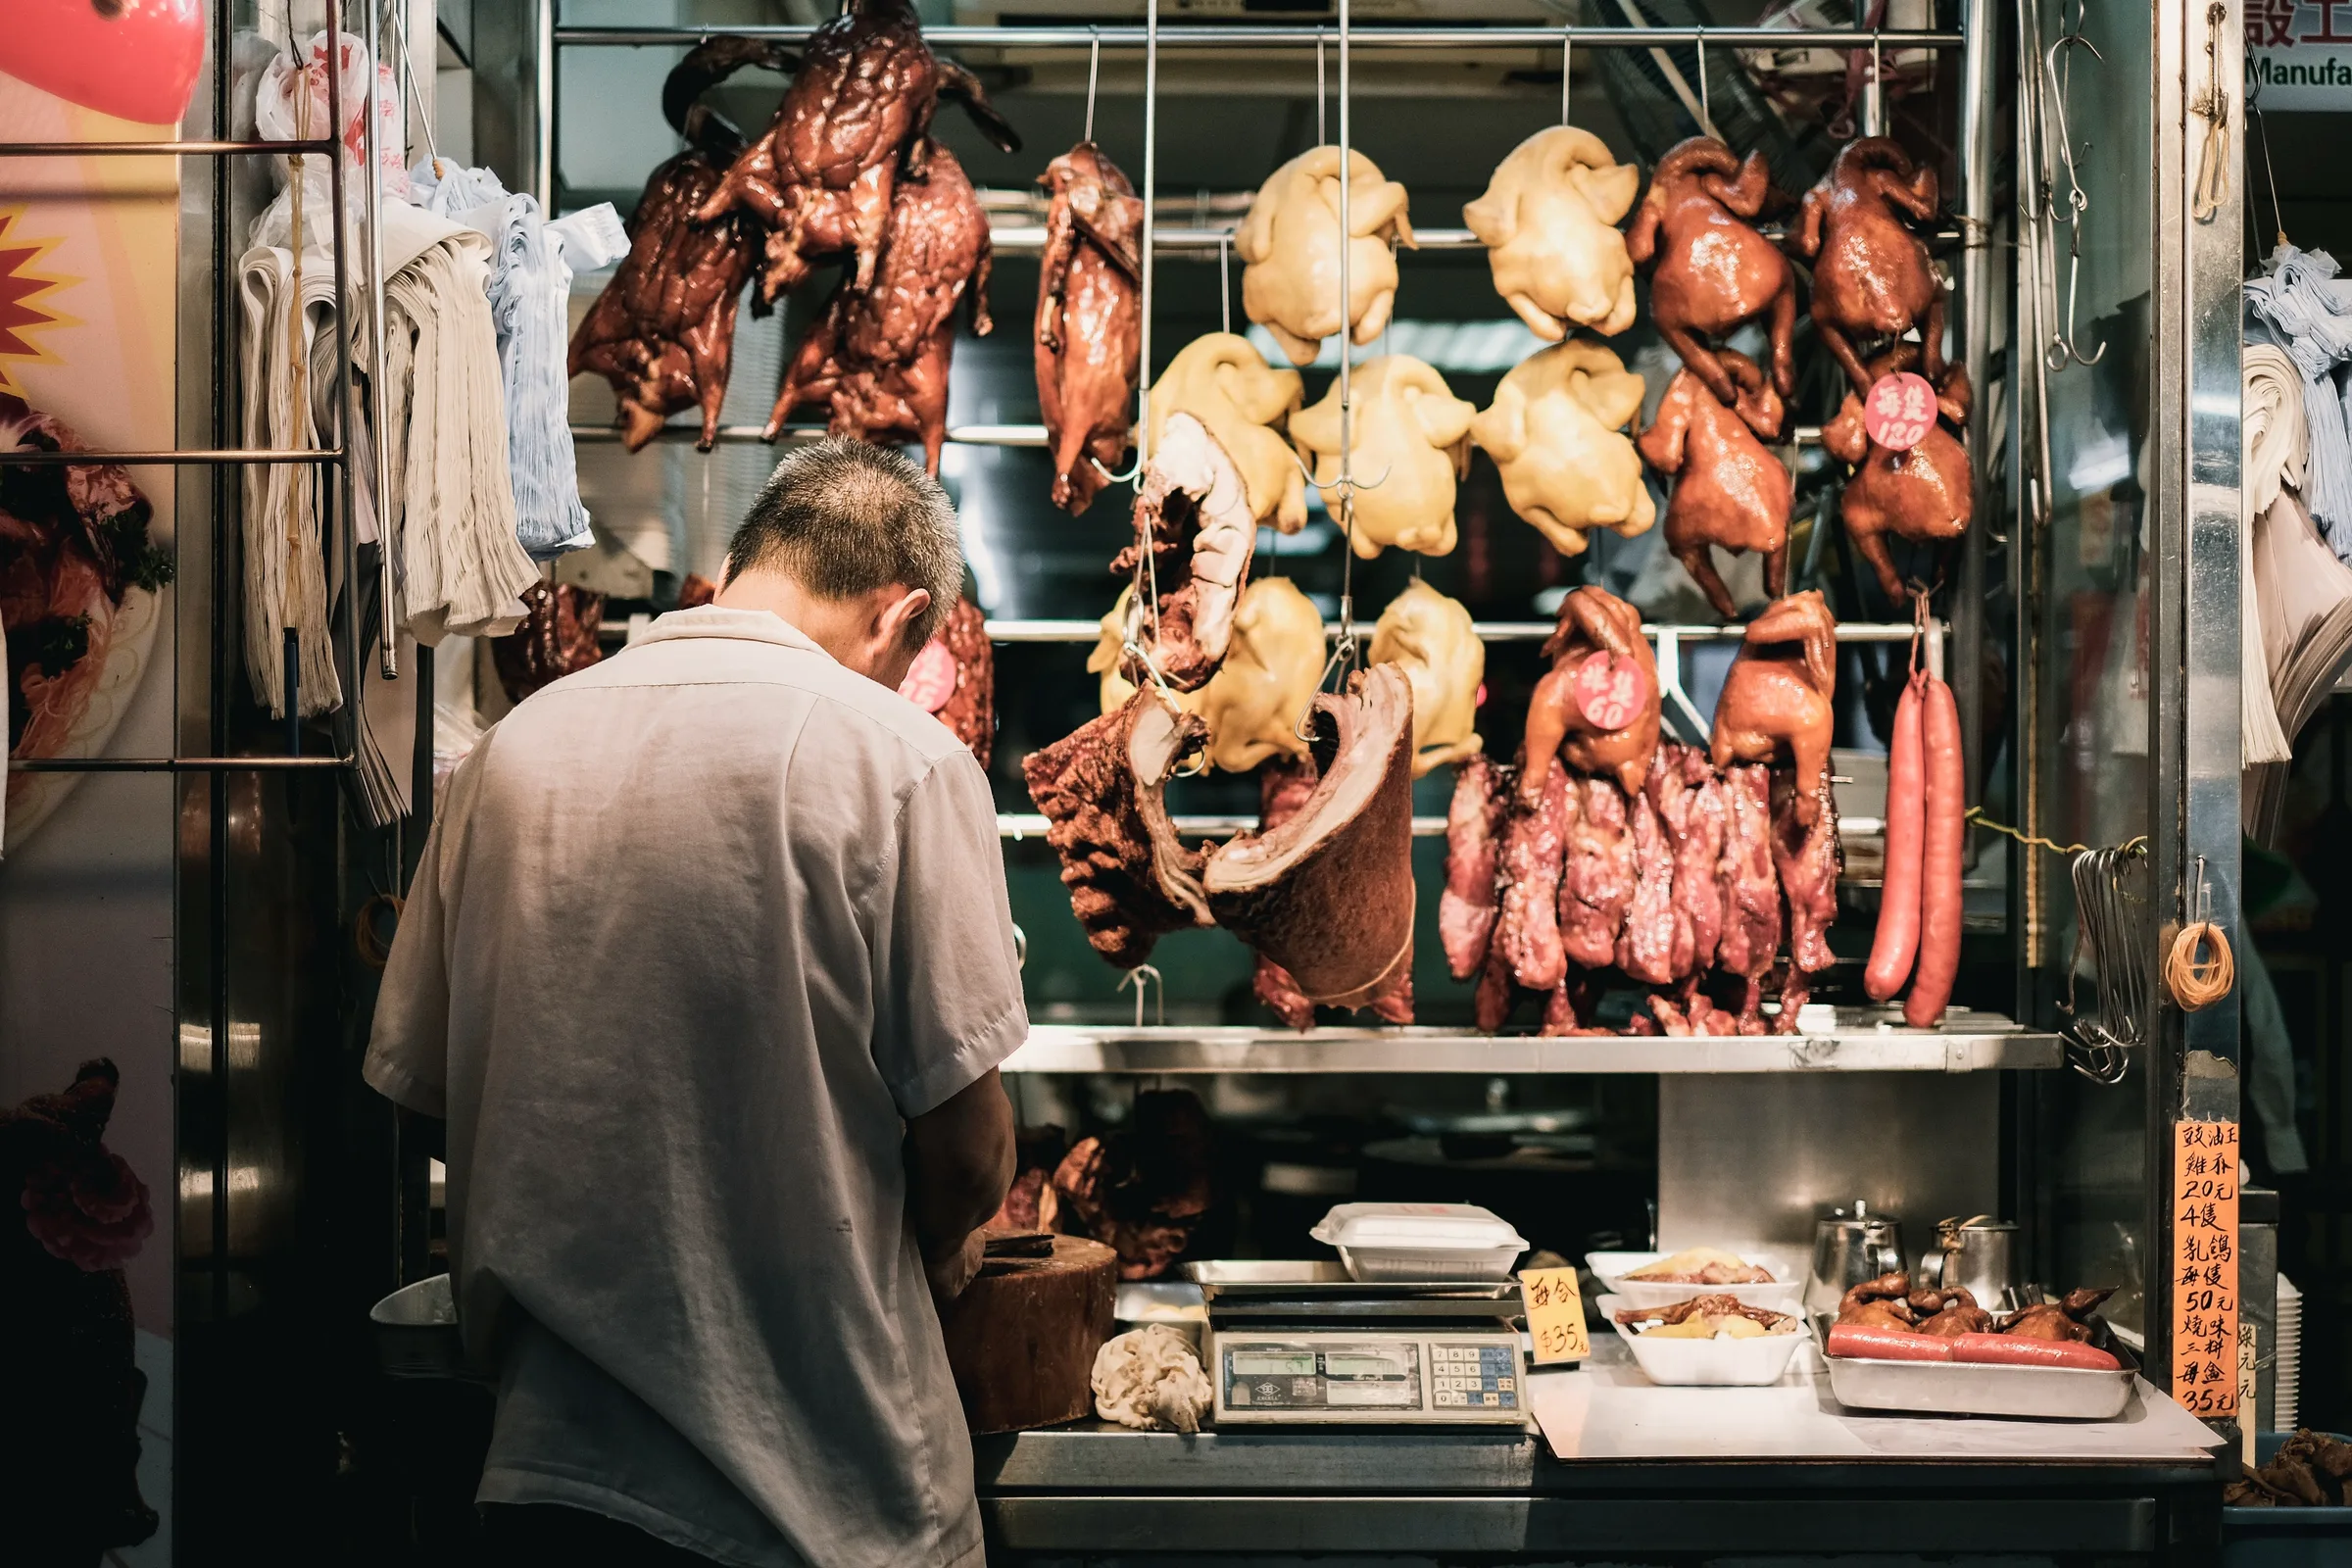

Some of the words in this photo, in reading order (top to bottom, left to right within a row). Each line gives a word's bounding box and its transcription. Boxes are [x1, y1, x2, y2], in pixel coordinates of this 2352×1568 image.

[2244, 57, 2352, 85] Manufa
[1586, 696, 1624, 730] 60
[2182, 1125, 2237, 1149] 豉油王
[2180, 1180, 2232, 1200] 20元
[2180, 1202, 2228, 1232] 4隻
[2181, 1234, 2231, 1262] 乳鴿
[2175, 1262, 2230, 1290] 每隻
[2183, 1290, 2233, 1312] 50元
[2180, 1313, 2231, 1339] 燒味
[2180, 1338, 2225, 1359] 三拼
[2182, 1389, 2233, 1412] 35元
